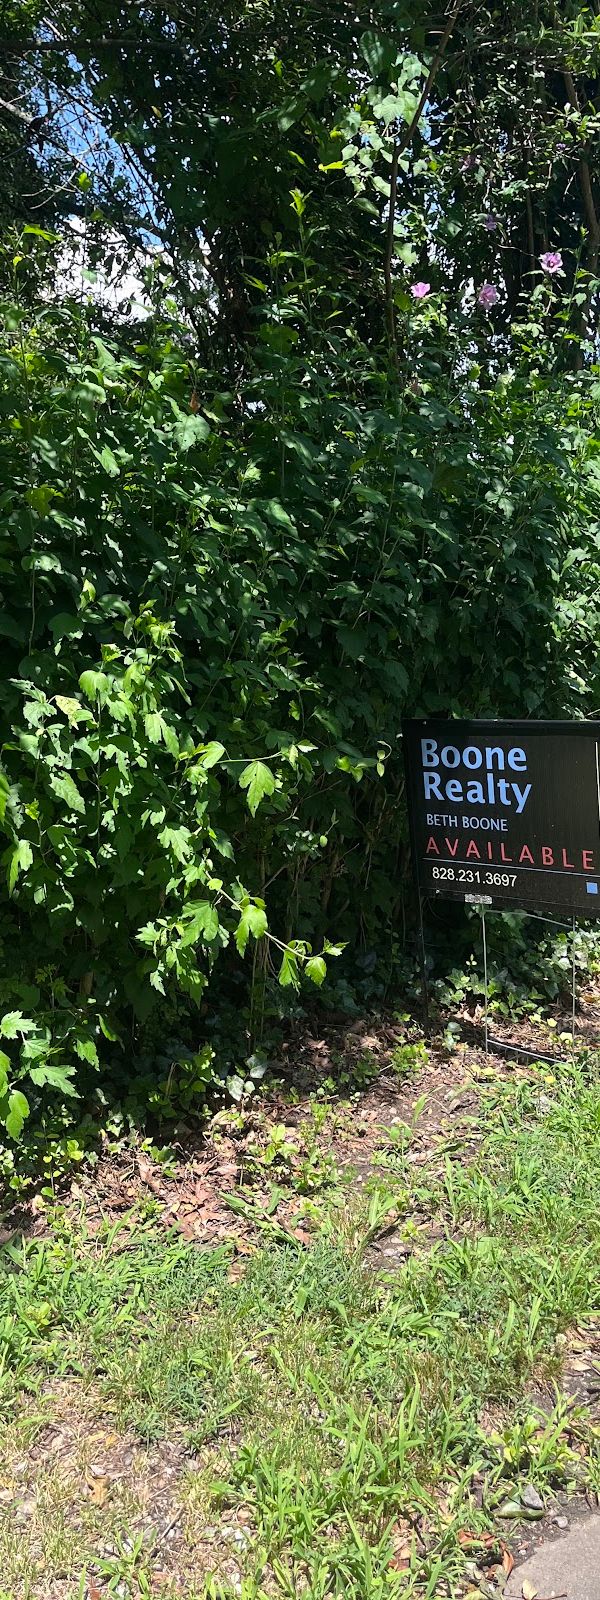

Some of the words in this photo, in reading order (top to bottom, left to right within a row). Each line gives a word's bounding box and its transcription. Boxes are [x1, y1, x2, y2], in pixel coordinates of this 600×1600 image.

[421, 739, 527, 771] Boone
[424, 772, 532, 813] Realty
[426, 814, 458, 828] BETH
[462, 816, 508, 832] BOONE
[426, 837, 595, 869] AVAILABLE
[432, 867, 517, 887] 828.231.3697
